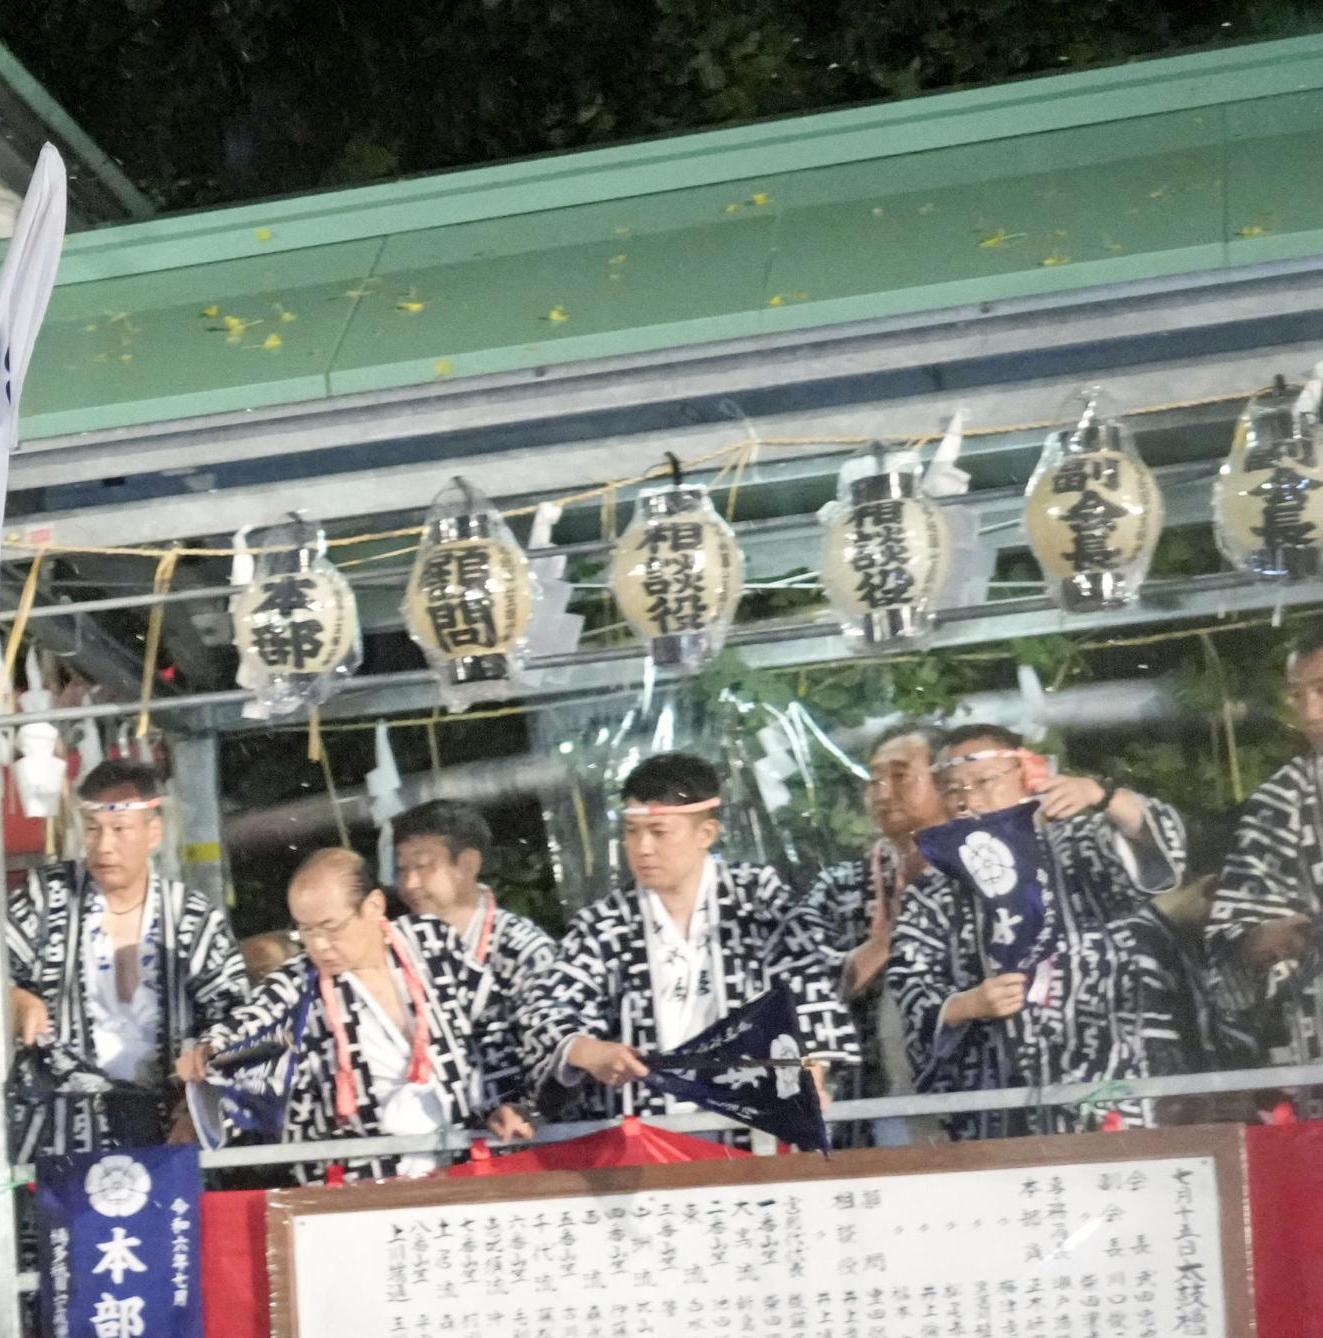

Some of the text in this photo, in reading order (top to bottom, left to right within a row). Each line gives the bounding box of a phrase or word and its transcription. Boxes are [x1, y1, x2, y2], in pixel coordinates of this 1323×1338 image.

[636, 522, 707, 634] 相談役
[843, 500, 915, 609] 相談役
[251, 576, 323, 670] 本部
[169, 1197, 191, 1308] 令和六年七月
[605, 1207, 629, 1275] 四番山笠
[656, 1203, 680, 1272] 三番山笠
[705, 1199, 729, 1266] 二番山笠
[756, 1199, 780, 1266] 一番山笠
